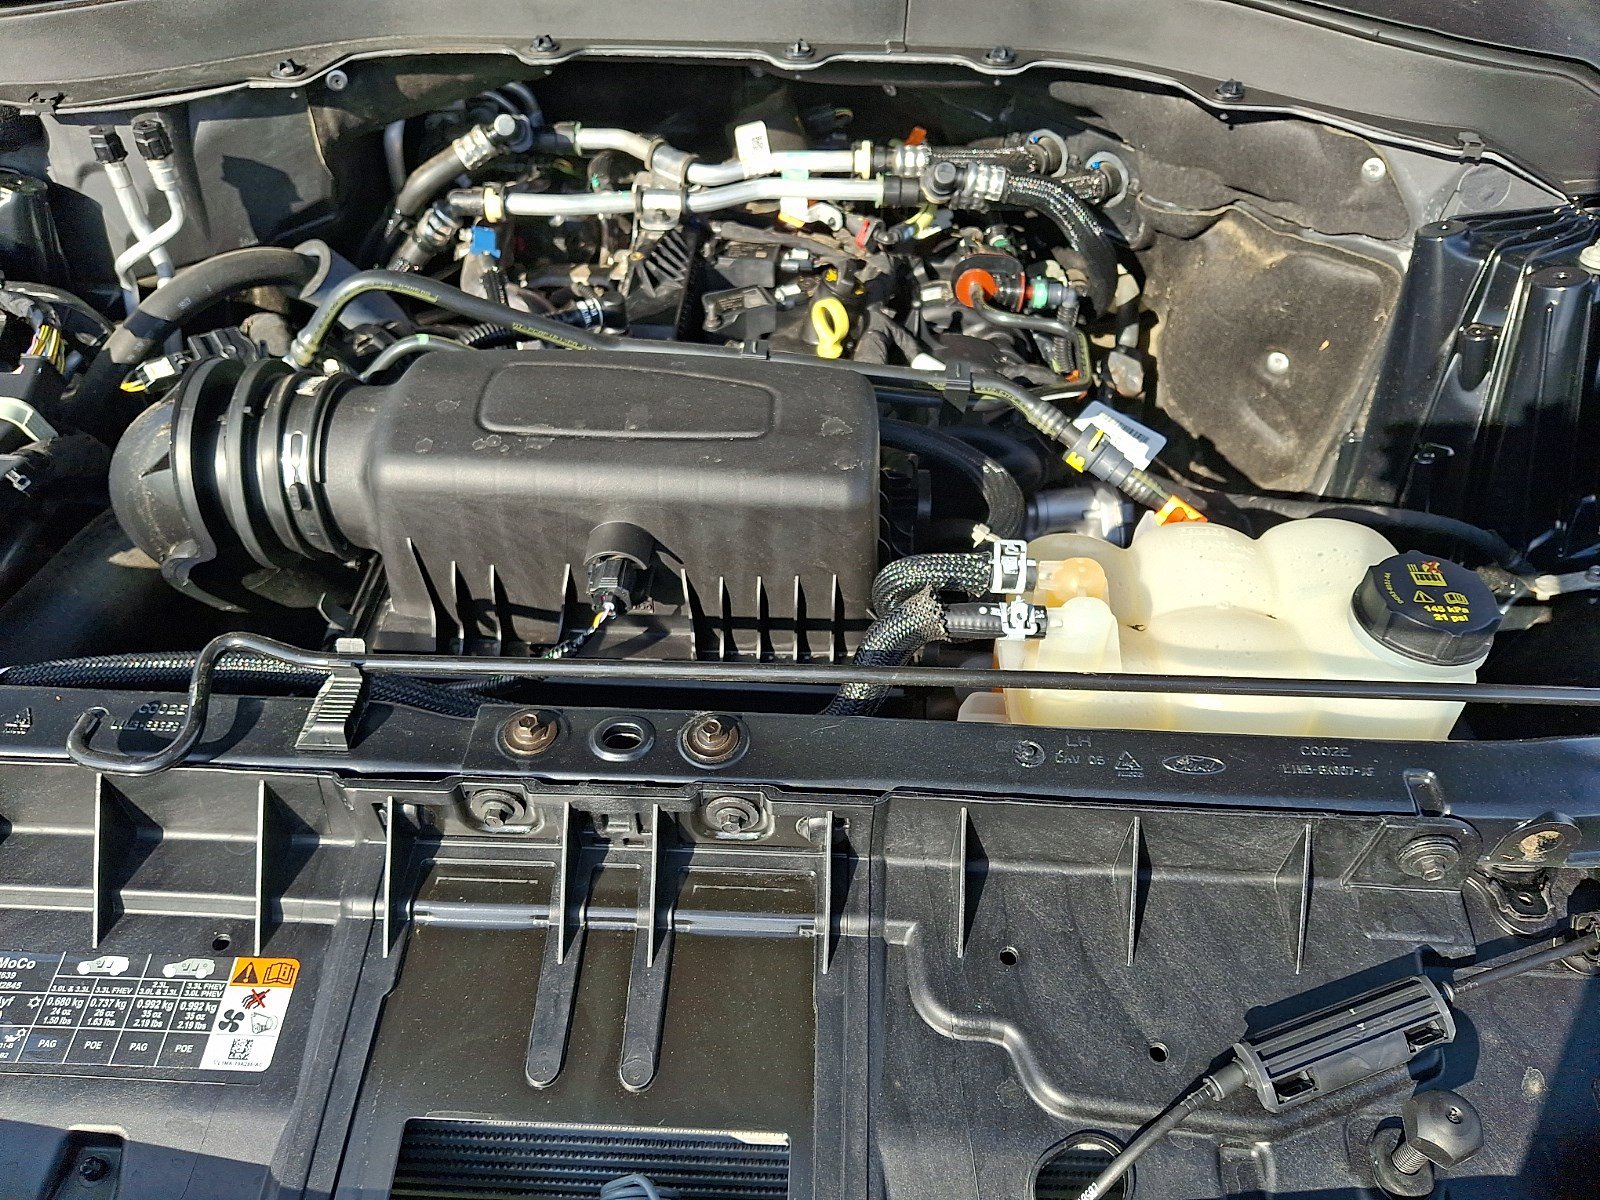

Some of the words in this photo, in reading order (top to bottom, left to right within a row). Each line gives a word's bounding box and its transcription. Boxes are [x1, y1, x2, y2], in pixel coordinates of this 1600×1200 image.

[1447, 605, 1469, 614] kPa
[46, 997, 71, 1007] 0.680
[71, 998, 84, 1009] kg
[90, 998, 115, 1008] 0.737
[114, 998, 127, 1011] kg
[136, 999, 162, 1009] 0.992
[161, 1000, 174, 1012] kg
[180, 1001, 205, 1011] 0.992
[204, 1002, 218, 1014] kg
[50, 1007, 62, 1015] 24
[94, 1009, 106, 1017] 26
[141, 1010, 153, 1018] 35
[152, 1011, 163, 1019] oz
[43, 1016, 60, 1024] 1.50
[59, 1017, 72, 1025] lbs
[184, 1012, 196, 1020] 35
[195, 1013, 207, 1021] oz
[87, 1018, 104, 1026] 1.63
[102, 1018, 115, 1027] lbs
[133, 1019, 150, 1027] 2.19
[150, 1019, 163, 1028] lbs
[176, 1021, 194, 1030] 2.19
[193, 1021, 207, 1030] lbs
[38, 1040, 57, 1048] PAG
[84, 1041, 103, 1050] POE
[129, 1043, 148, 1052] PAG
[174, 1044, 194, 1053] POE
